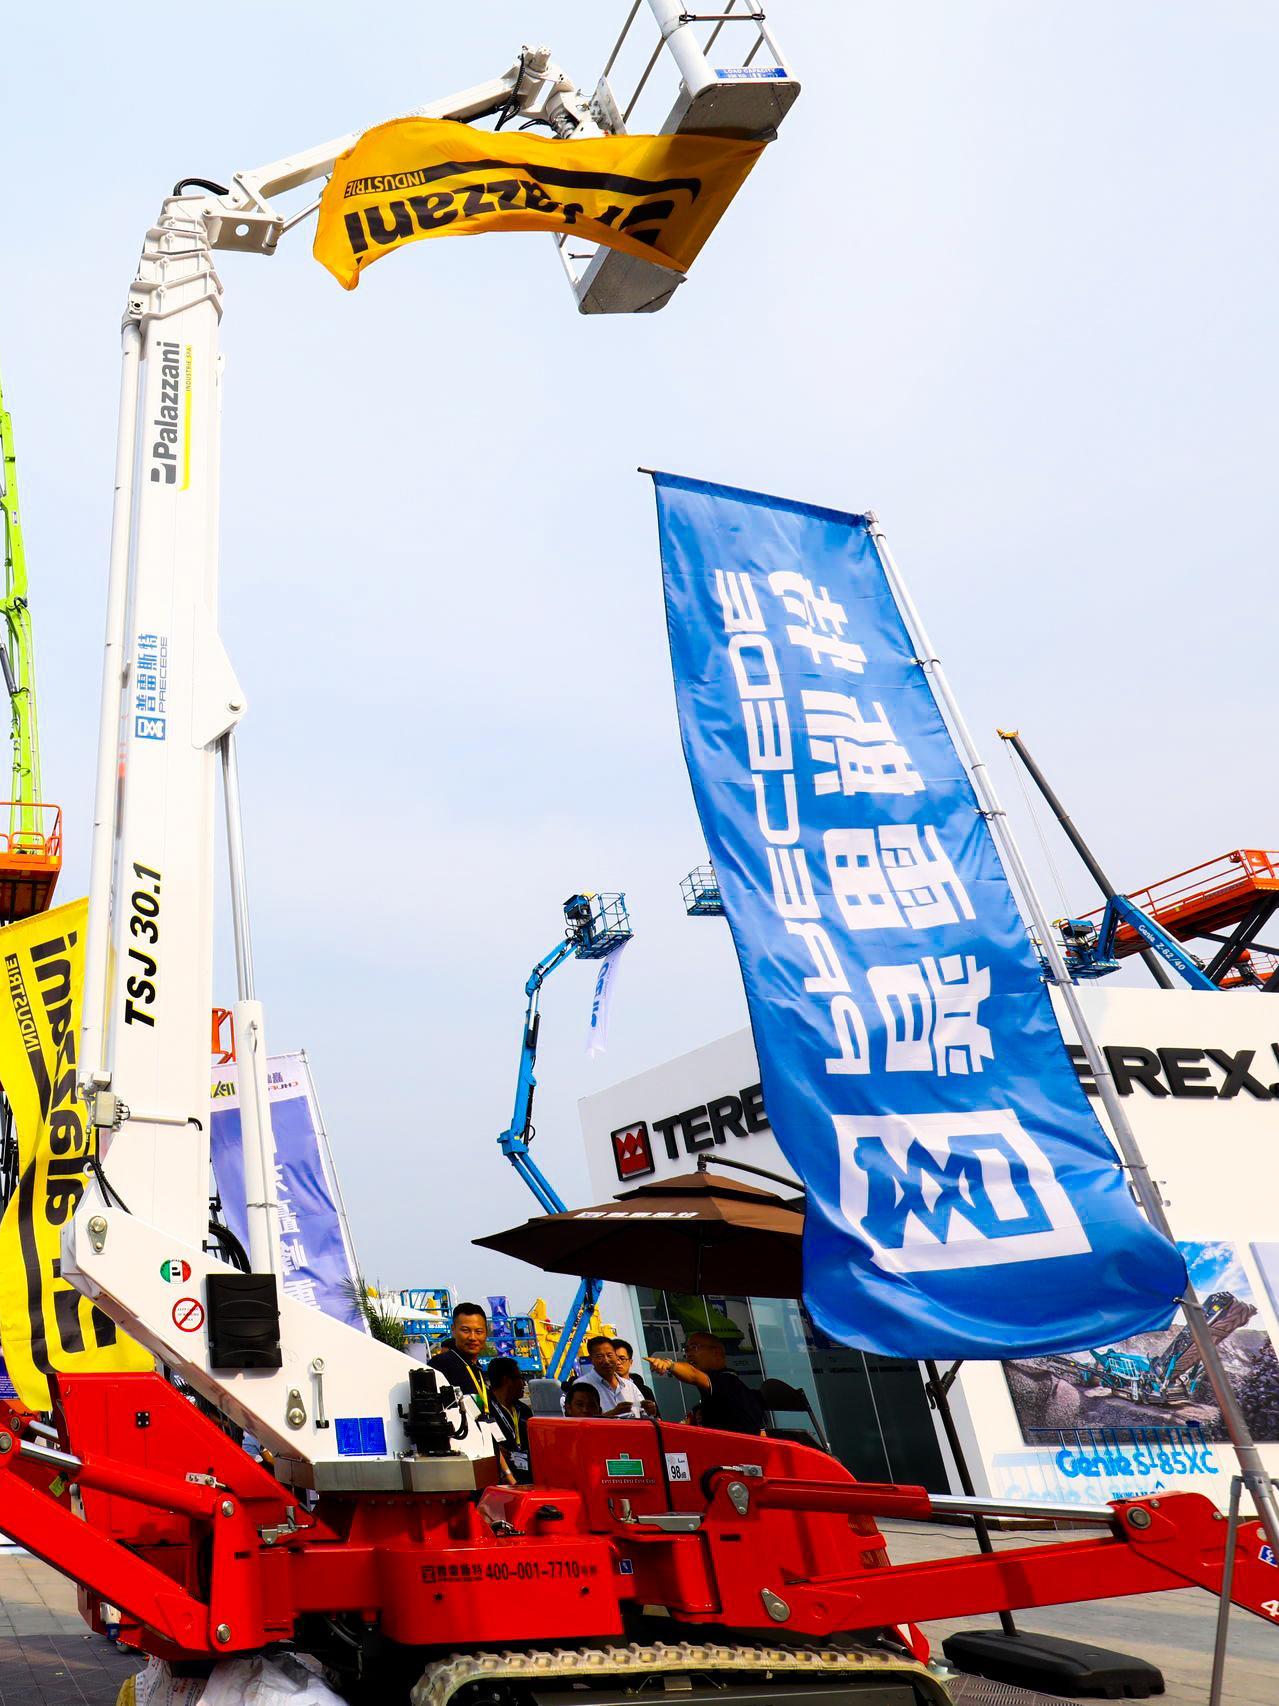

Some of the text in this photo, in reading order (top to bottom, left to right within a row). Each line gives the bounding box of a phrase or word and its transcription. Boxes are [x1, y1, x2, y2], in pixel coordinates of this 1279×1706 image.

[344, 170, 425, 198] INDUSTRIE
[152, 340, 180, 460] Palazzani
[136, 633, 158, 712] 普雷斯特
[158, 636, 168, 713] PRECEDE
[125, 861, 163, 1029] TSJ 30.1
[1138, 924, 1156, 944] Genie
[1065, 1043, 1271, 1101] EREX
[652, 1084, 770, 1160] TERE
[670, 1466, 680, 1479] 98
[1056, 1449, 1219, 1478] Genie S-85XC
[485, 1560, 580, 1580] 400-001-7710
[1261, 1600, 1279, 1617] 4
